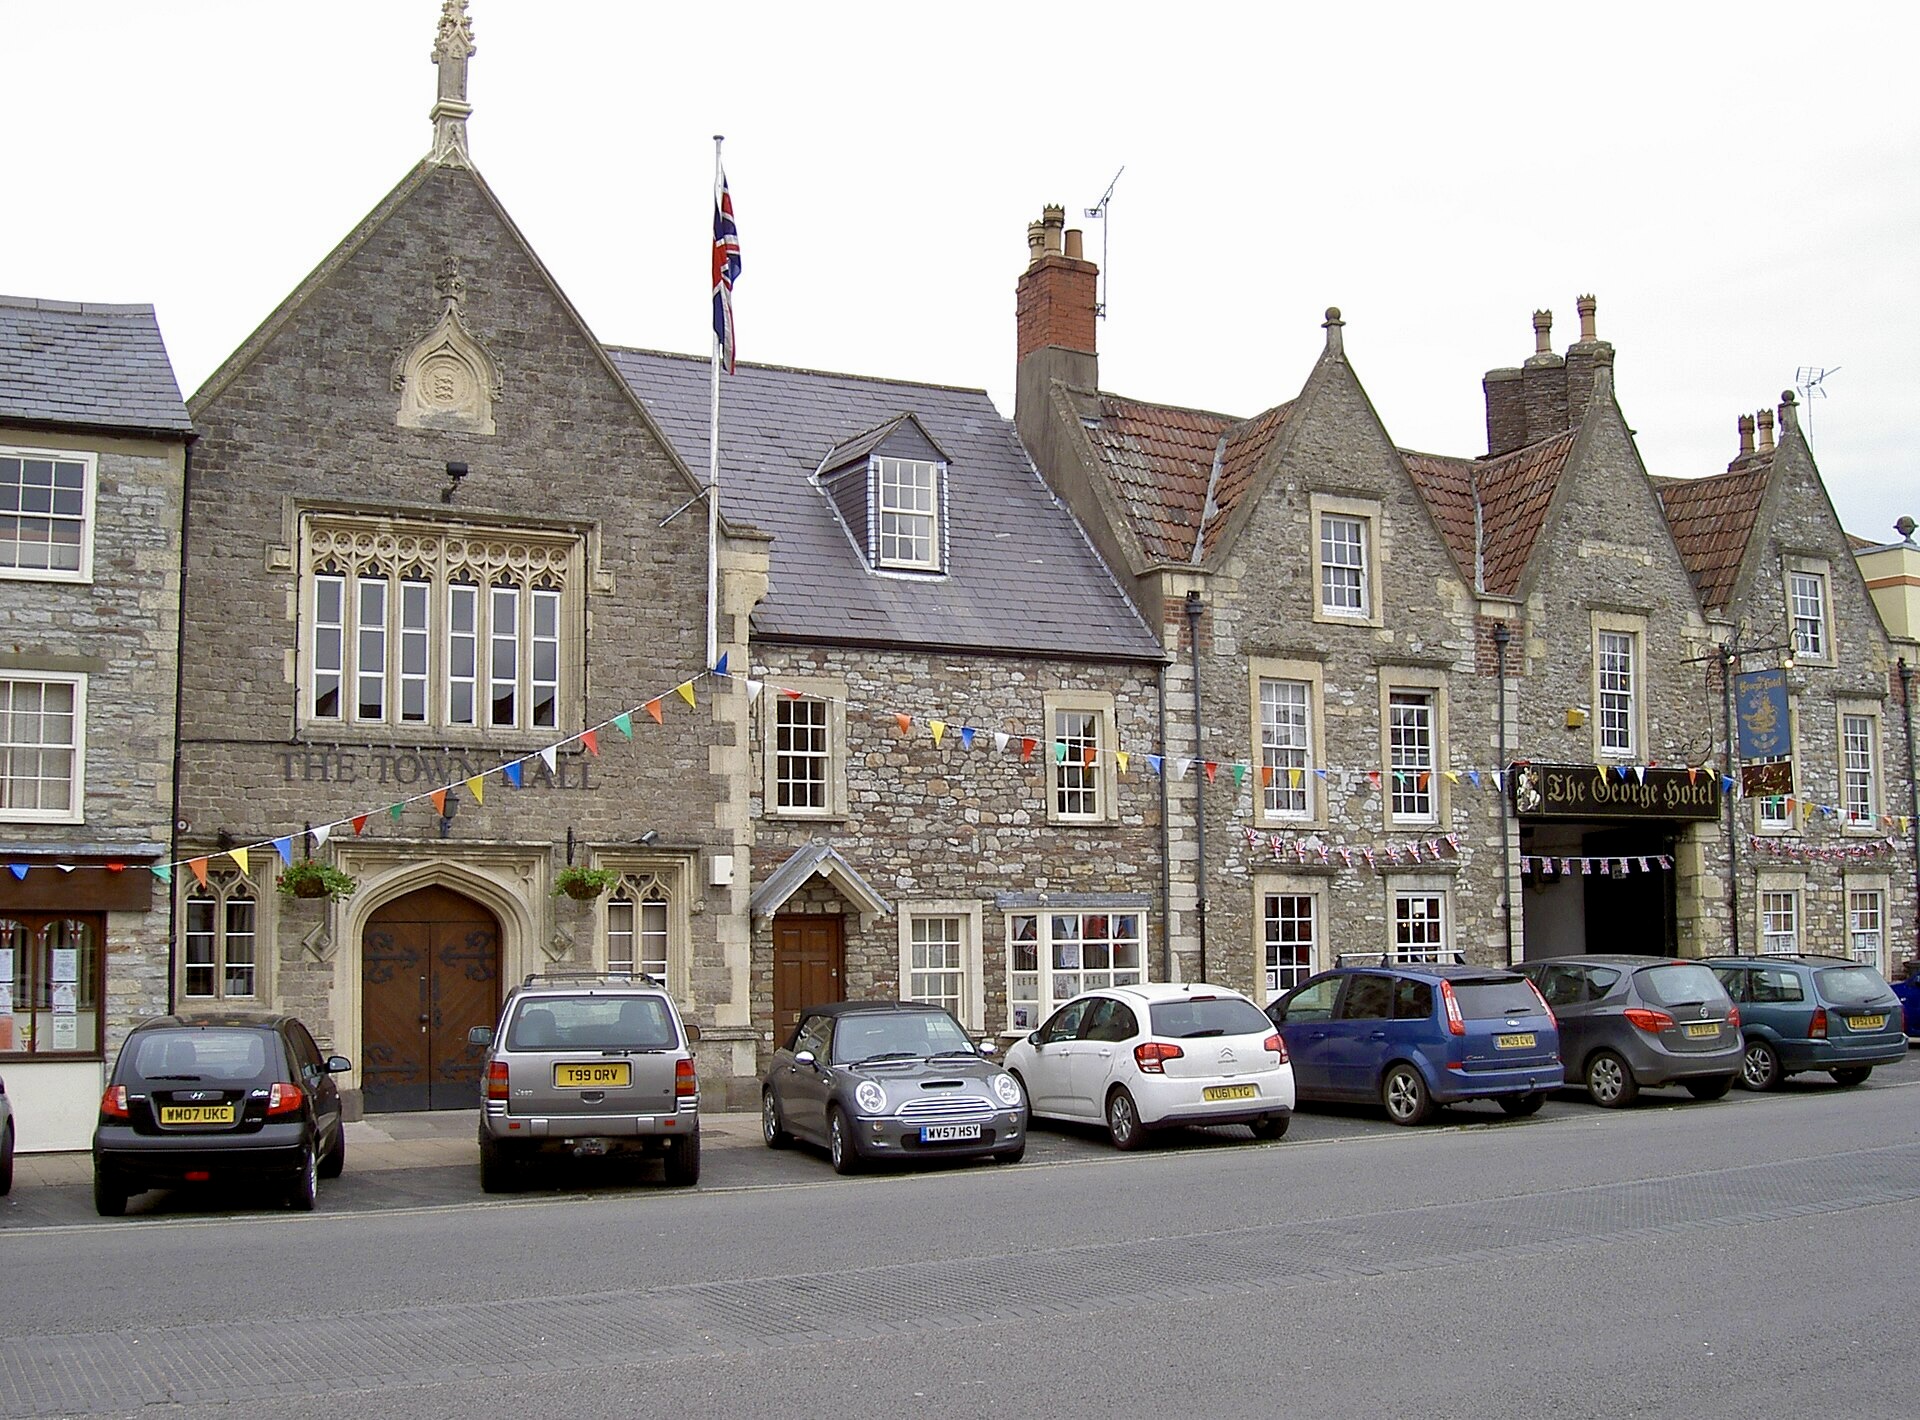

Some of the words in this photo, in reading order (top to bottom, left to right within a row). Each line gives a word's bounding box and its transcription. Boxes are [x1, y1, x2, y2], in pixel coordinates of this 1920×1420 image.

[276, 751, 358, 783] THE
[372, 753, 484, 785] TOWN
[1547, 773, 1586, 806] The
[1591, 775, 1659, 809] George
[1663, 779, 1715, 810] Hotel
[568, 1069, 591, 1081] T99
[1209, 1087, 1231, 1099] VU61
[167, 1108, 200, 1121] WM07
[203, 1108, 229, 1120] UKC
[928, 1126, 957, 1138] WV57
[958, 1125, 979, 1137] HSY
